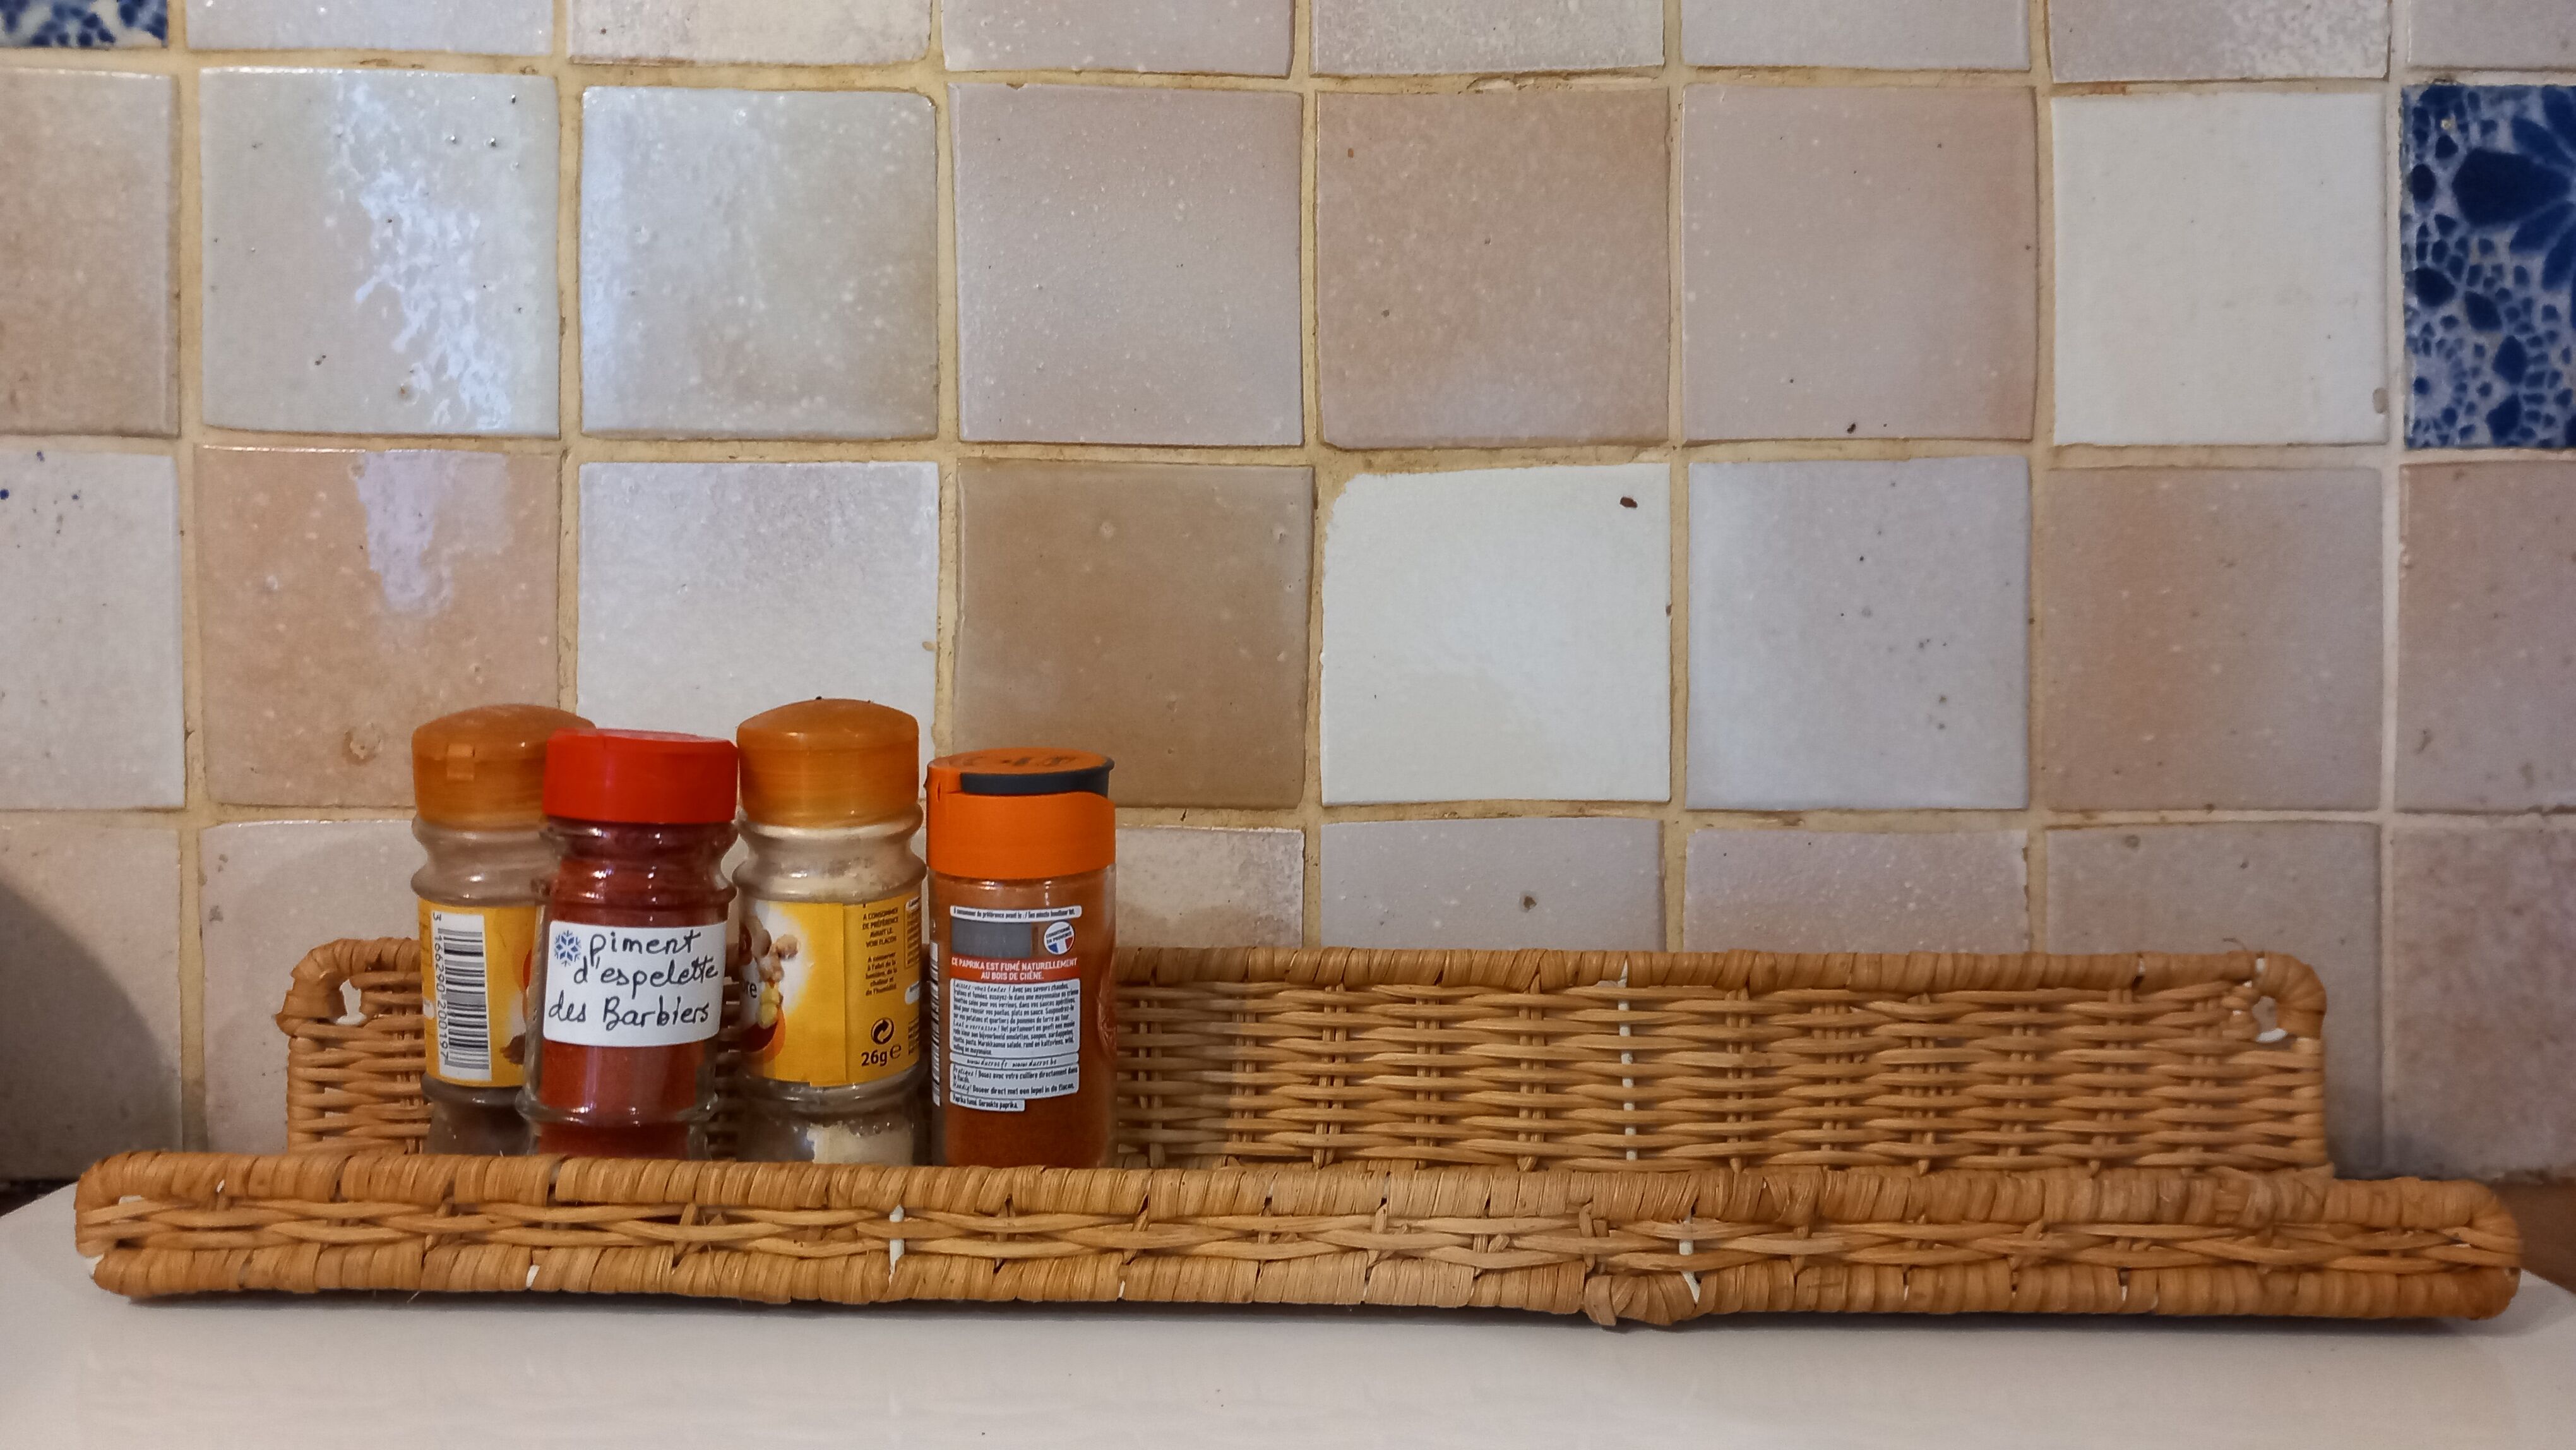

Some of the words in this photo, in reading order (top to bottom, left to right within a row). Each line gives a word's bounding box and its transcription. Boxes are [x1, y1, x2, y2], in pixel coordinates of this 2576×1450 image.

[433, 913, 441, 921] 3
[434, 935, 446, 993] 166290
[951, 957, 958, 966] CE
[959, 959, 985, 970] PAPRIKA
[986, 962, 999, 971] EST
[1001, 961, 1020, 971] FUMÉ
[1022, 957, 1078, 971] NATURELLEMENT
[573, 955, 719, 1000] d'espelette
[1014, 993, 1024, 1001] dans
[548, 990, 587, 1022] des
[603, 995, 710, 1031] Barbiers
[437, 1000, 449, 1061] 200197
[861, 1049, 888, 1067] 26g
[1005, 1071, 1018, 1079] votre
[991, 1086, 1006, 1094] direct
